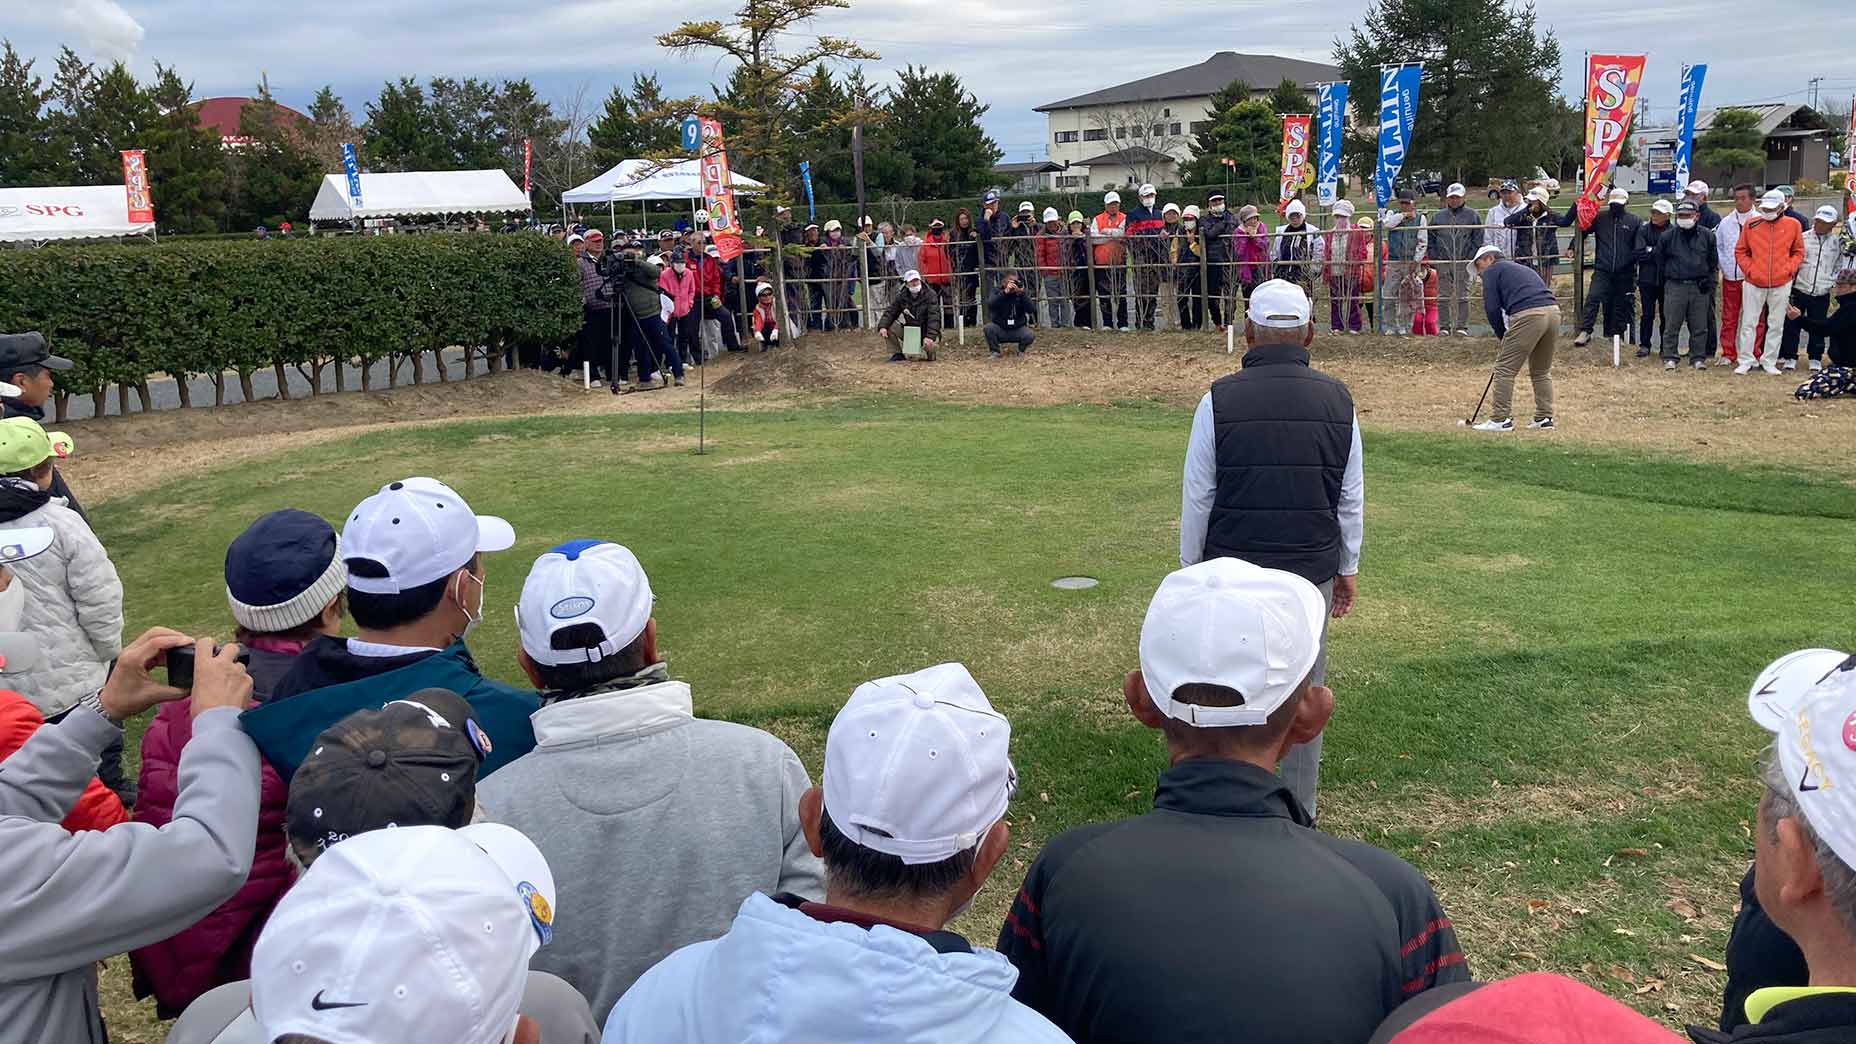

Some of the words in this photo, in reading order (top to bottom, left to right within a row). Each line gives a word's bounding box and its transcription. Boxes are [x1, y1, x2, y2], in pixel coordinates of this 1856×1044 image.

[687, 124, 697, 145] 9
[1318, 84, 1338, 183] NITTAX
[25, 204, 84, 217] SPG
